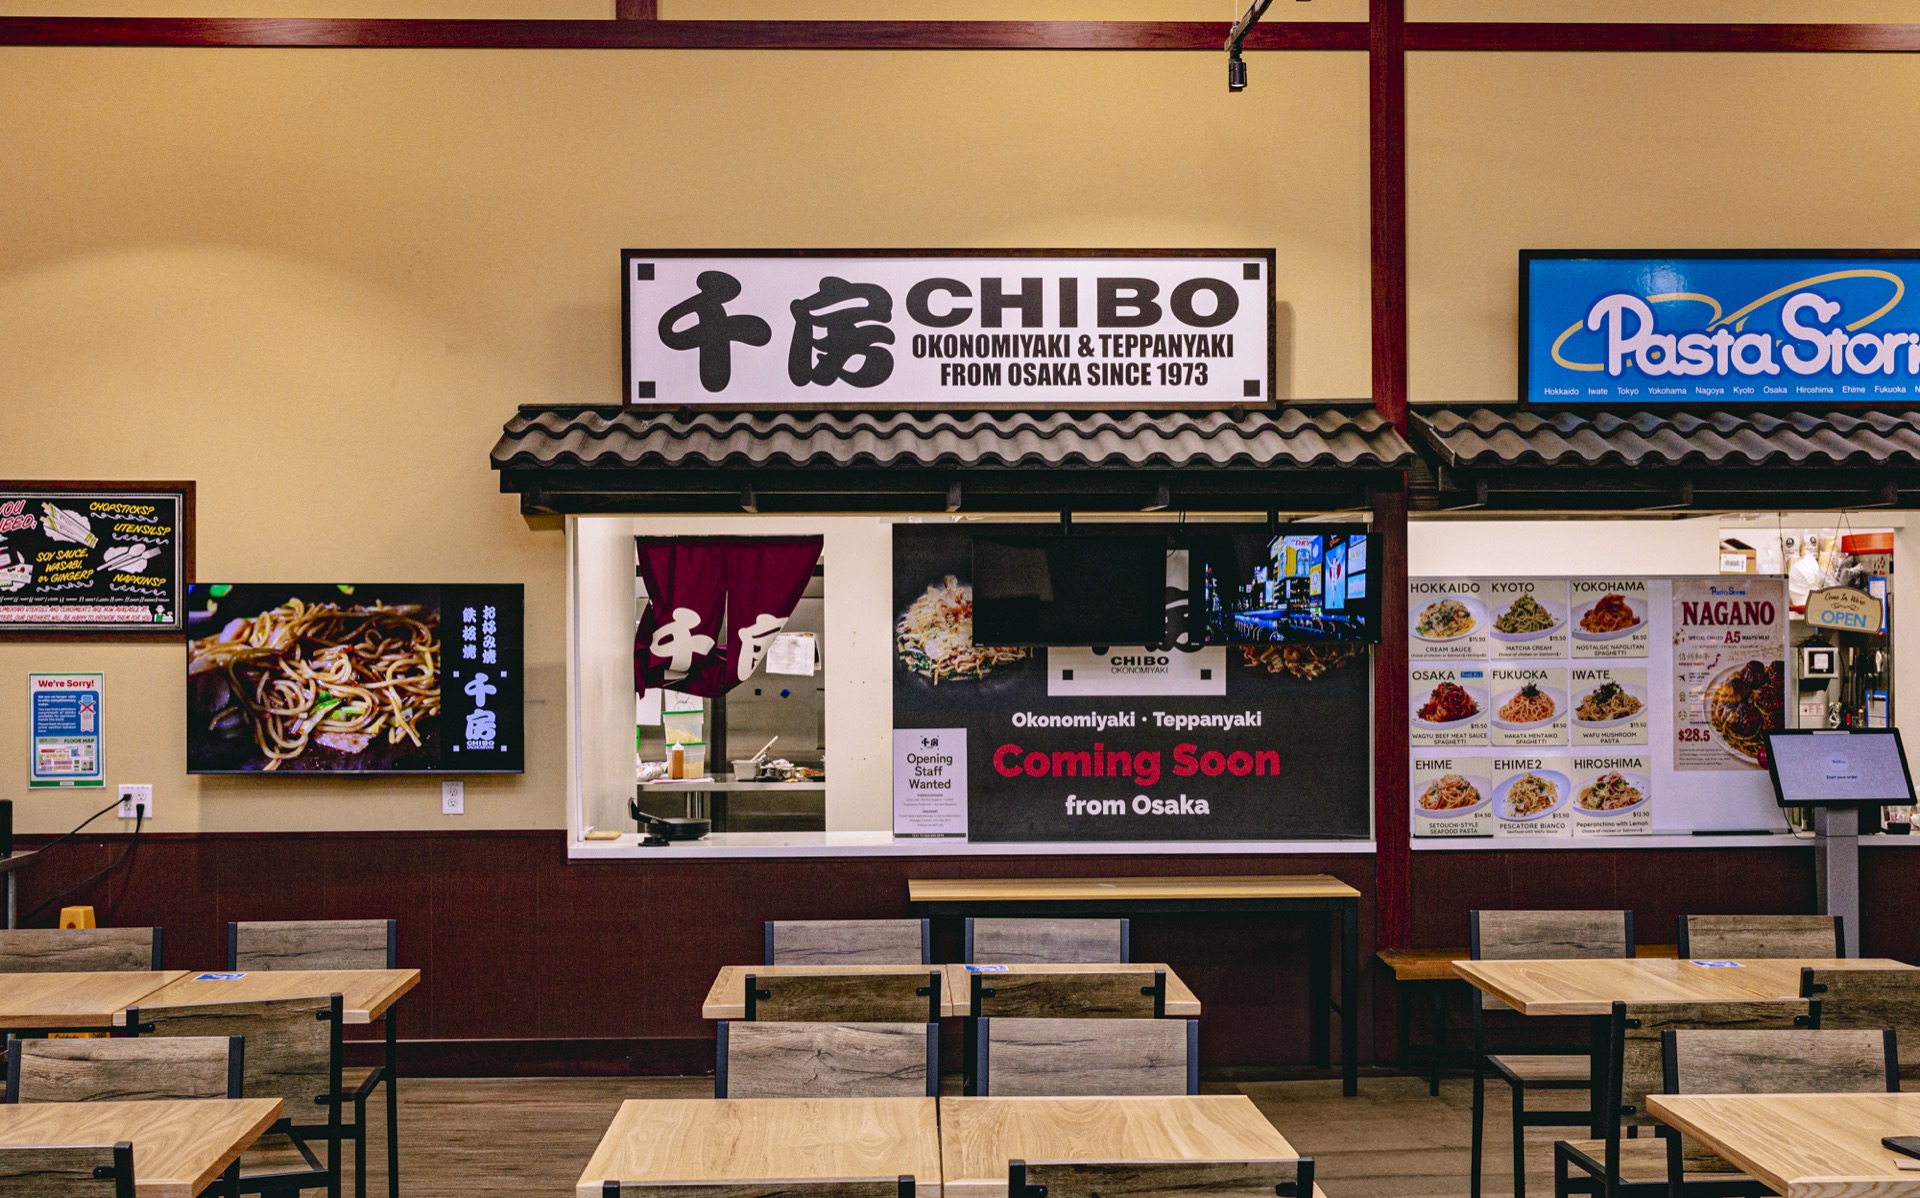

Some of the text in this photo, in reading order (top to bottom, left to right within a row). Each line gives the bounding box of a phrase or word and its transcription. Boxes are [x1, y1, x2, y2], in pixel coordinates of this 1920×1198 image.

[905, 277, 1240, 328] CHIBO
[658, 271, 895, 393] 千房
[1588, 293, 1920, 376] Pasta Stori
[912, 333, 1234, 358] OKONOMIYAKI & TEPPANYAKI
[941, 362, 1208, 386] FROM OSAKA SINCE 1973
[1544, 387, 1579, 396] Hokkaido
[1588, 387, 1608, 395] Iwate
[1617, 387, 1639, 396] Tokyo
[1648, 387, 1687, 395] Yokohama
[1695, 387, 1725, 396] Nagoya
[1733, 386, 1754, 395] Kyoto
[1763, 386, 1788, 394] Osaka
[1796, 385, 1834, 394] Hiroshima
[1874, 385, 1907, 393] Fukuoka
[89, 502, 155, 515] CHOPSTICKS?
[114, 523, 171, 536] UTENSILS?
[36, 551, 54, 562] SOY
[51, 569, 94, 583] GINGER?
[113, 573, 166, 587] NAPKINS?
[1410, 583, 1480, 593] HOKKAIDO
[1491, 582, 1535, 592] KYOTO
[1572, 582, 1645, 592] YOKOHAMA
[1681, 601, 1775, 626] NAGANO
[1821, 609, 1867, 628] OPEN
[1724, 631, 1741, 643] A5
[1111, 656, 1169, 666] CHIBO
[1412, 671, 1455, 681] OSAKA
[1492, 670, 1548, 680] FUKUOKA
[1572, 670, 1610, 680] IWATE
[38, 680, 95, 689] We're Sorry!
[464, 672, 497, 740] 千房
[1011, 712, 1136, 731] Okonomiyaki
[1153, 711, 1262, 731] Teppanyaki
[1678, 728, 1710, 742] $28.5
[906, 753, 953, 766] Opening
[993, 742, 1280, 787] Coming Soon
[1415, 760, 1452, 770] EHIME
[1494, 759, 1542, 770] EHIME2
[1574, 758, 1642, 769] HIROSHIMA
[915, 766, 943, 777] Staff
[908, 778, 952, 789] Wanted
[1065, 794, 1210, 815] from Osaka
